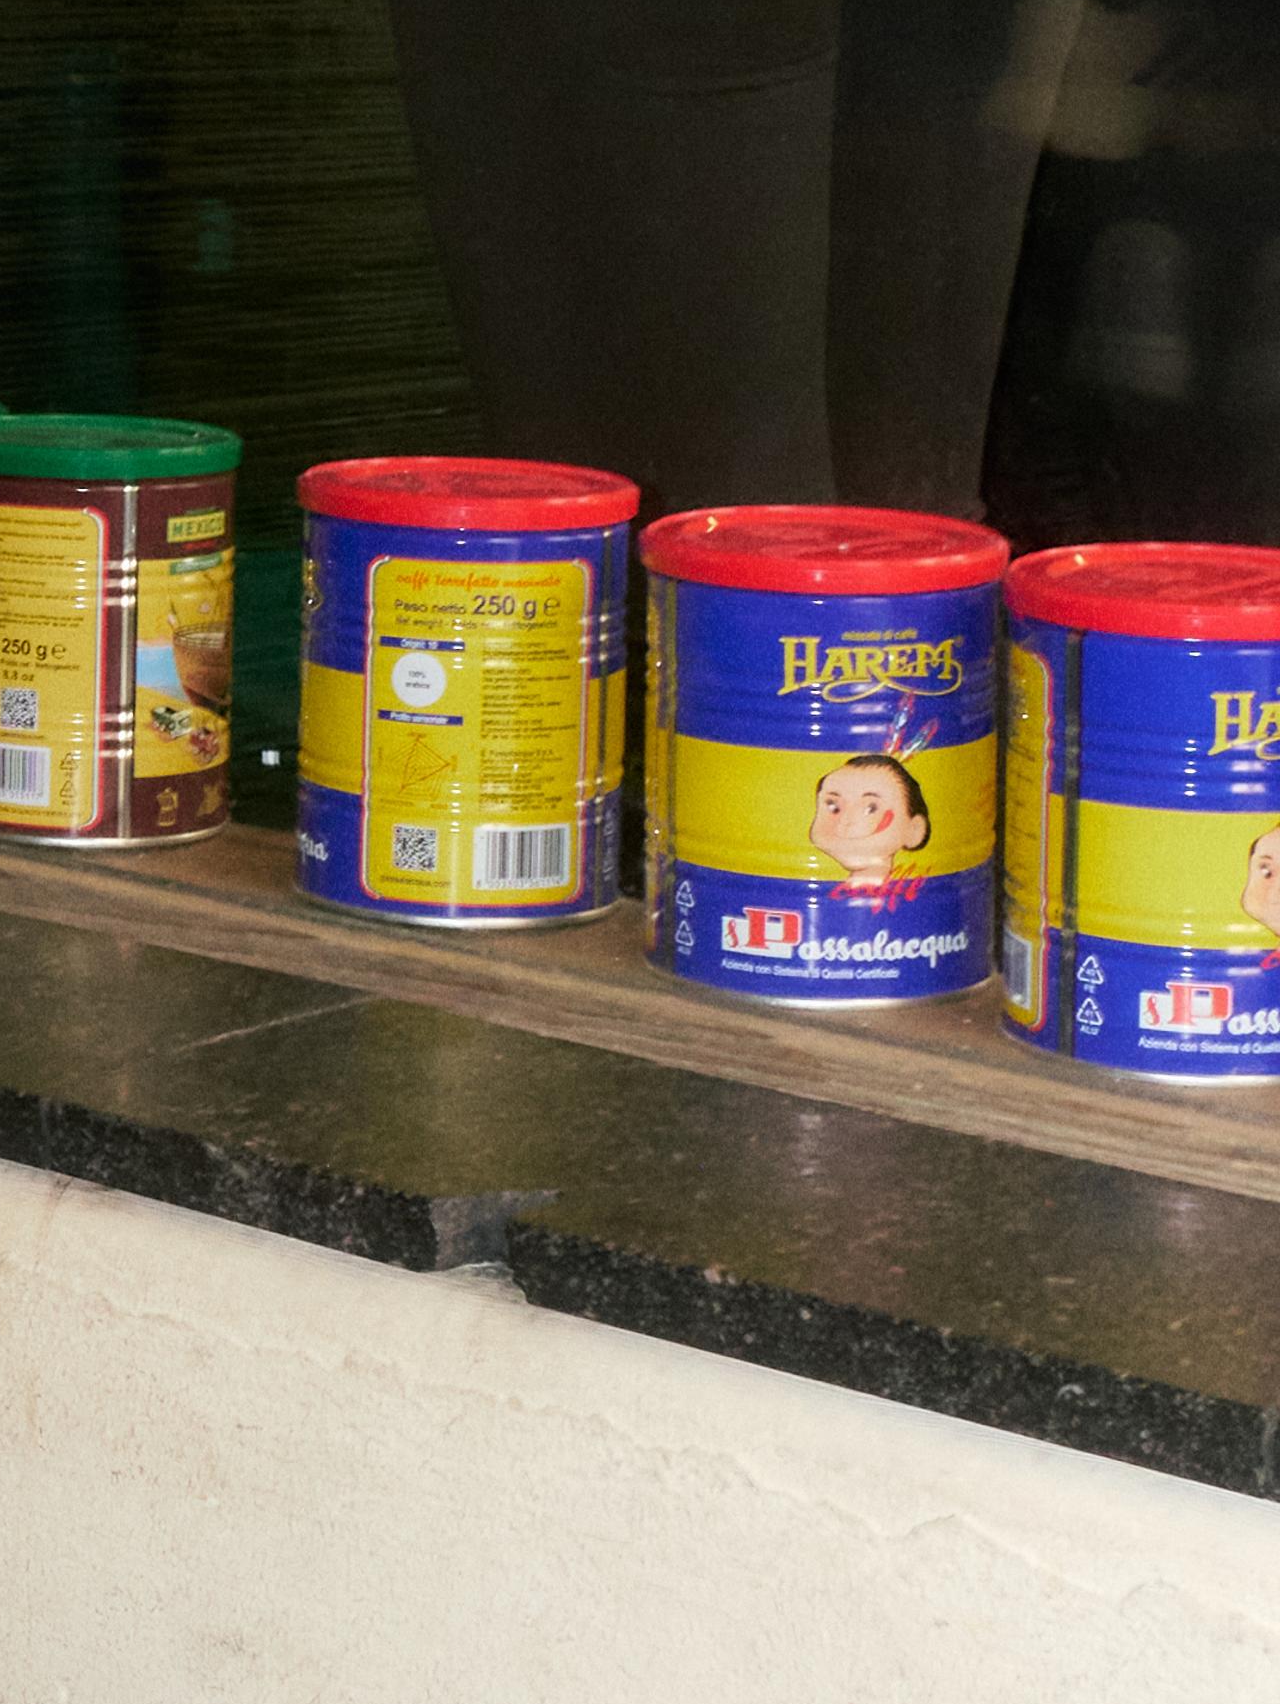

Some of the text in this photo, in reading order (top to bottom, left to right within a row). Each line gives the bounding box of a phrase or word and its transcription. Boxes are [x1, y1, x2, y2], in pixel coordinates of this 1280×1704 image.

[473, 595, 516, 615] 250
[523, 601, 537, 619] g
[2, 638, 31, 656] 250
[36, 646, 47, 660] g
[777, 636, 962, 704] HAREM
[744, 907, 968, 969] Passalacqua
